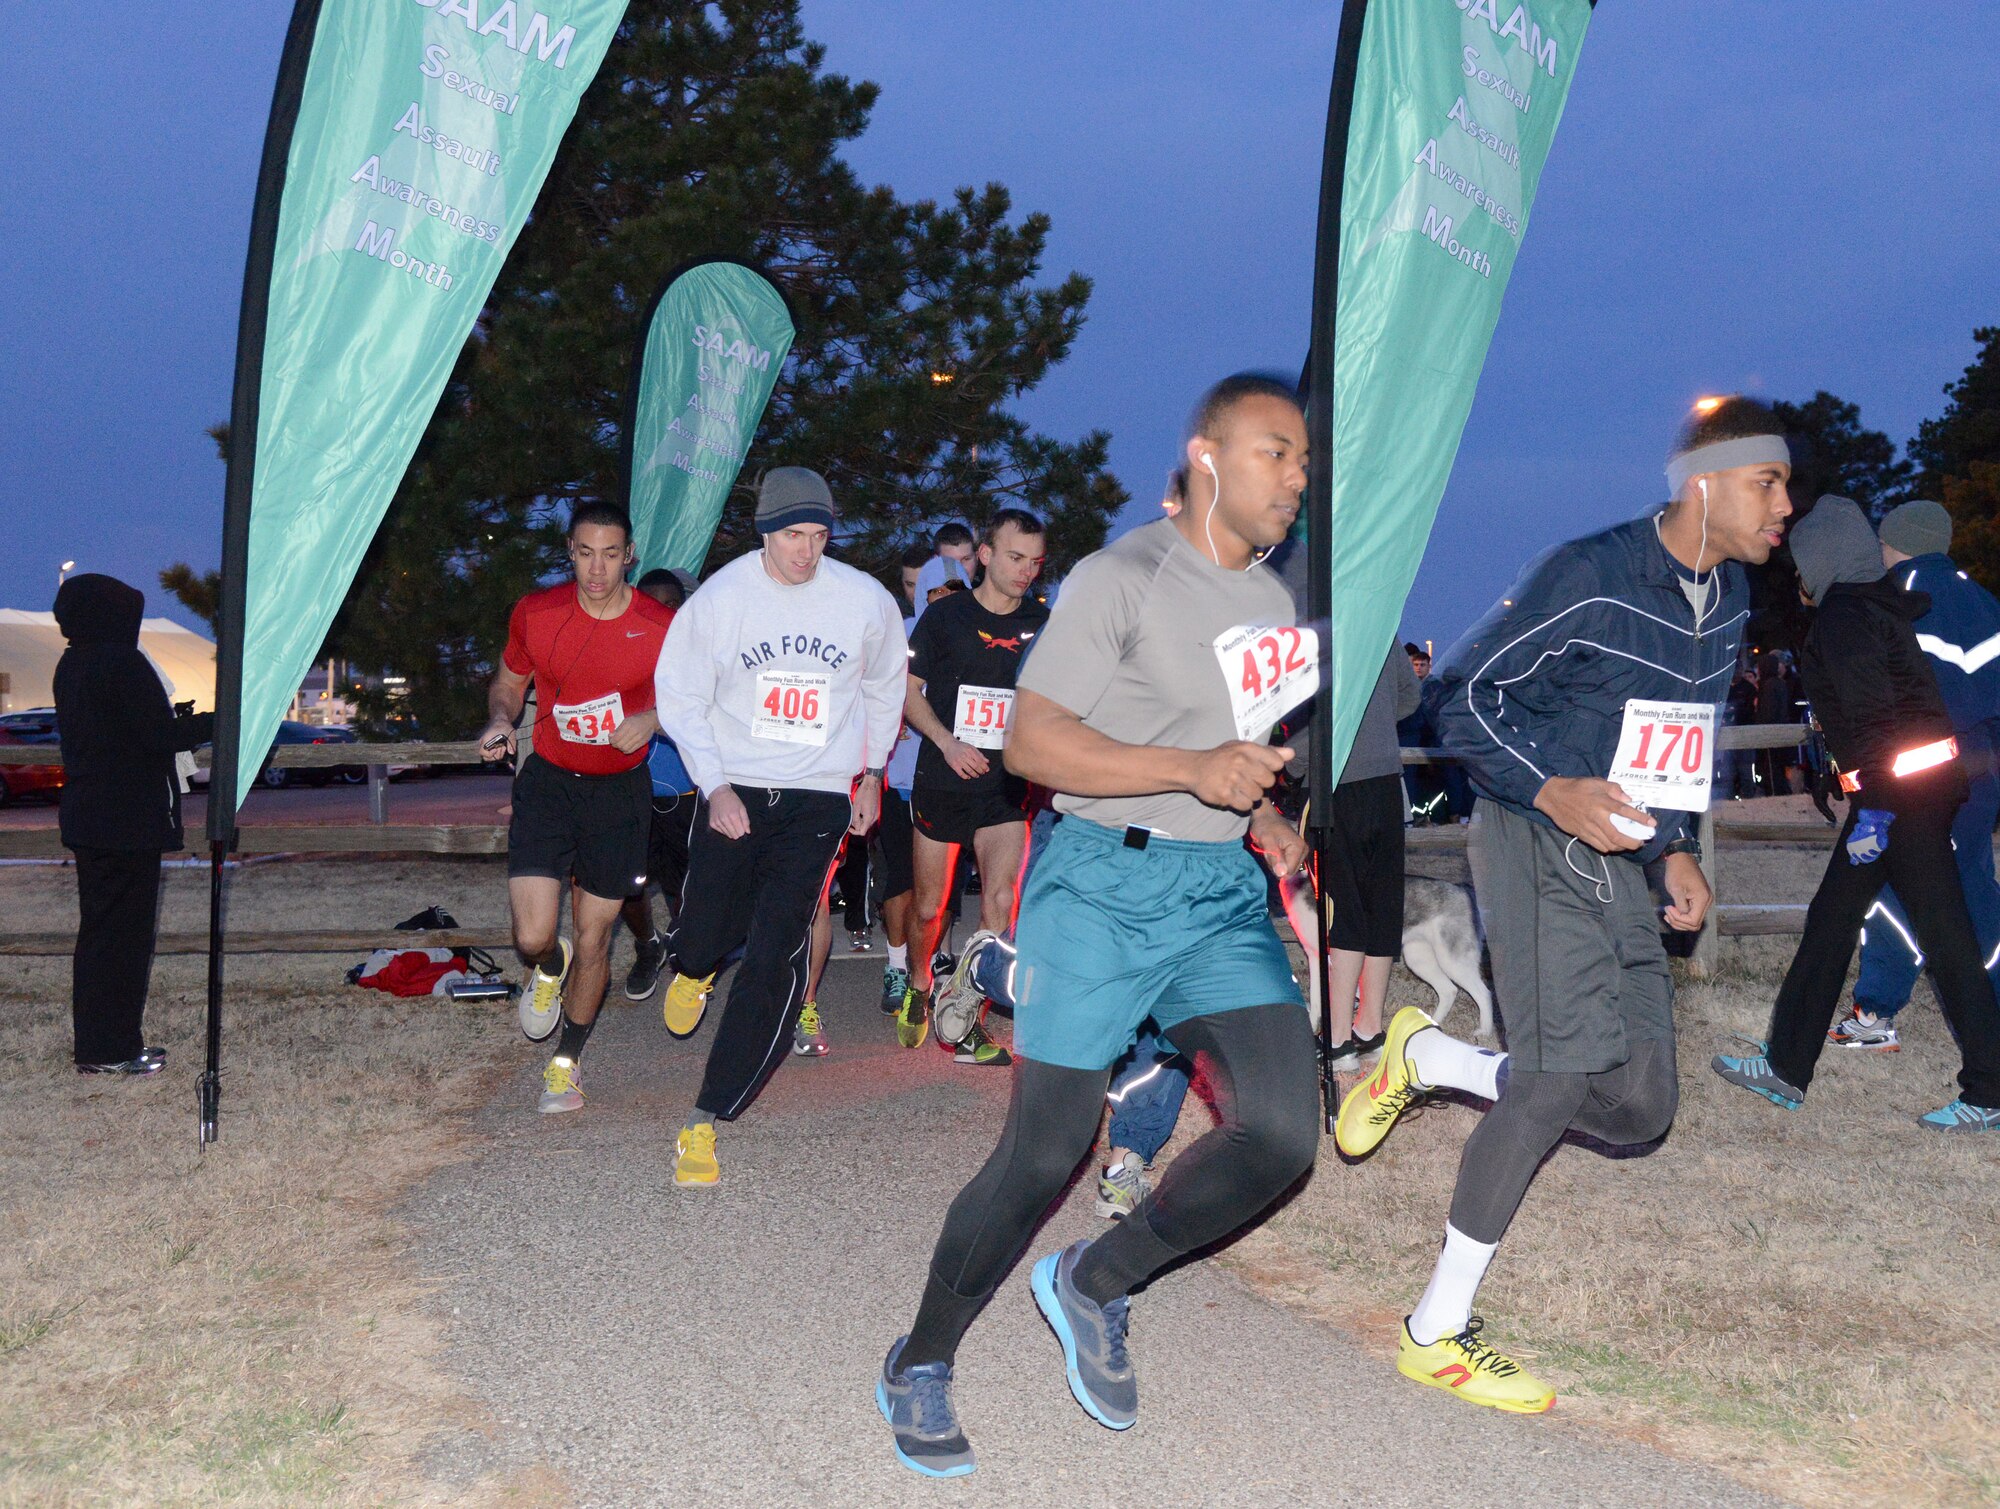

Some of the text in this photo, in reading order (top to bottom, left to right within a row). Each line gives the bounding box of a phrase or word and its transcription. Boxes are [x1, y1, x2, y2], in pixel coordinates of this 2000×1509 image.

[411, 0, 577, 70] AAM
[1455, 0, 1557, 78] AAM
[418, 43, 521, 116] Sexual
[1460, 44, 1532, 115] Sexual
[393, 101, 501, 177] Assault
[1446, 96, 1521, 171] Assault
[350, 153, 501, 244] Awareness
[1413, 137, 1520, 237] Awareness
[354, 220, 454, 291] Month
[1420, 204, 1492, 279] Month
[691, 325, 771, 372] SAAM
[687, 393, 738, 424] Assault
[698, 365, 745, 395] Sexual
[667, 417, 739, 459] Awareness
[672, 450, 718, 483] Month
[740, 634, 848, 670] AIR FORCE
[1242, 626, 1305, 698] 432
[566, 709, 616, 739] 434
[763, 686, 819, 721] 406
[964, 698, 1005, 729] 151
[1633, 709, 1660, 719] Monthly
[1674, 711, 1686, 719] Run
[1687, 712, 1698, 720] and
[1629, 723, 1703, 774] 170
